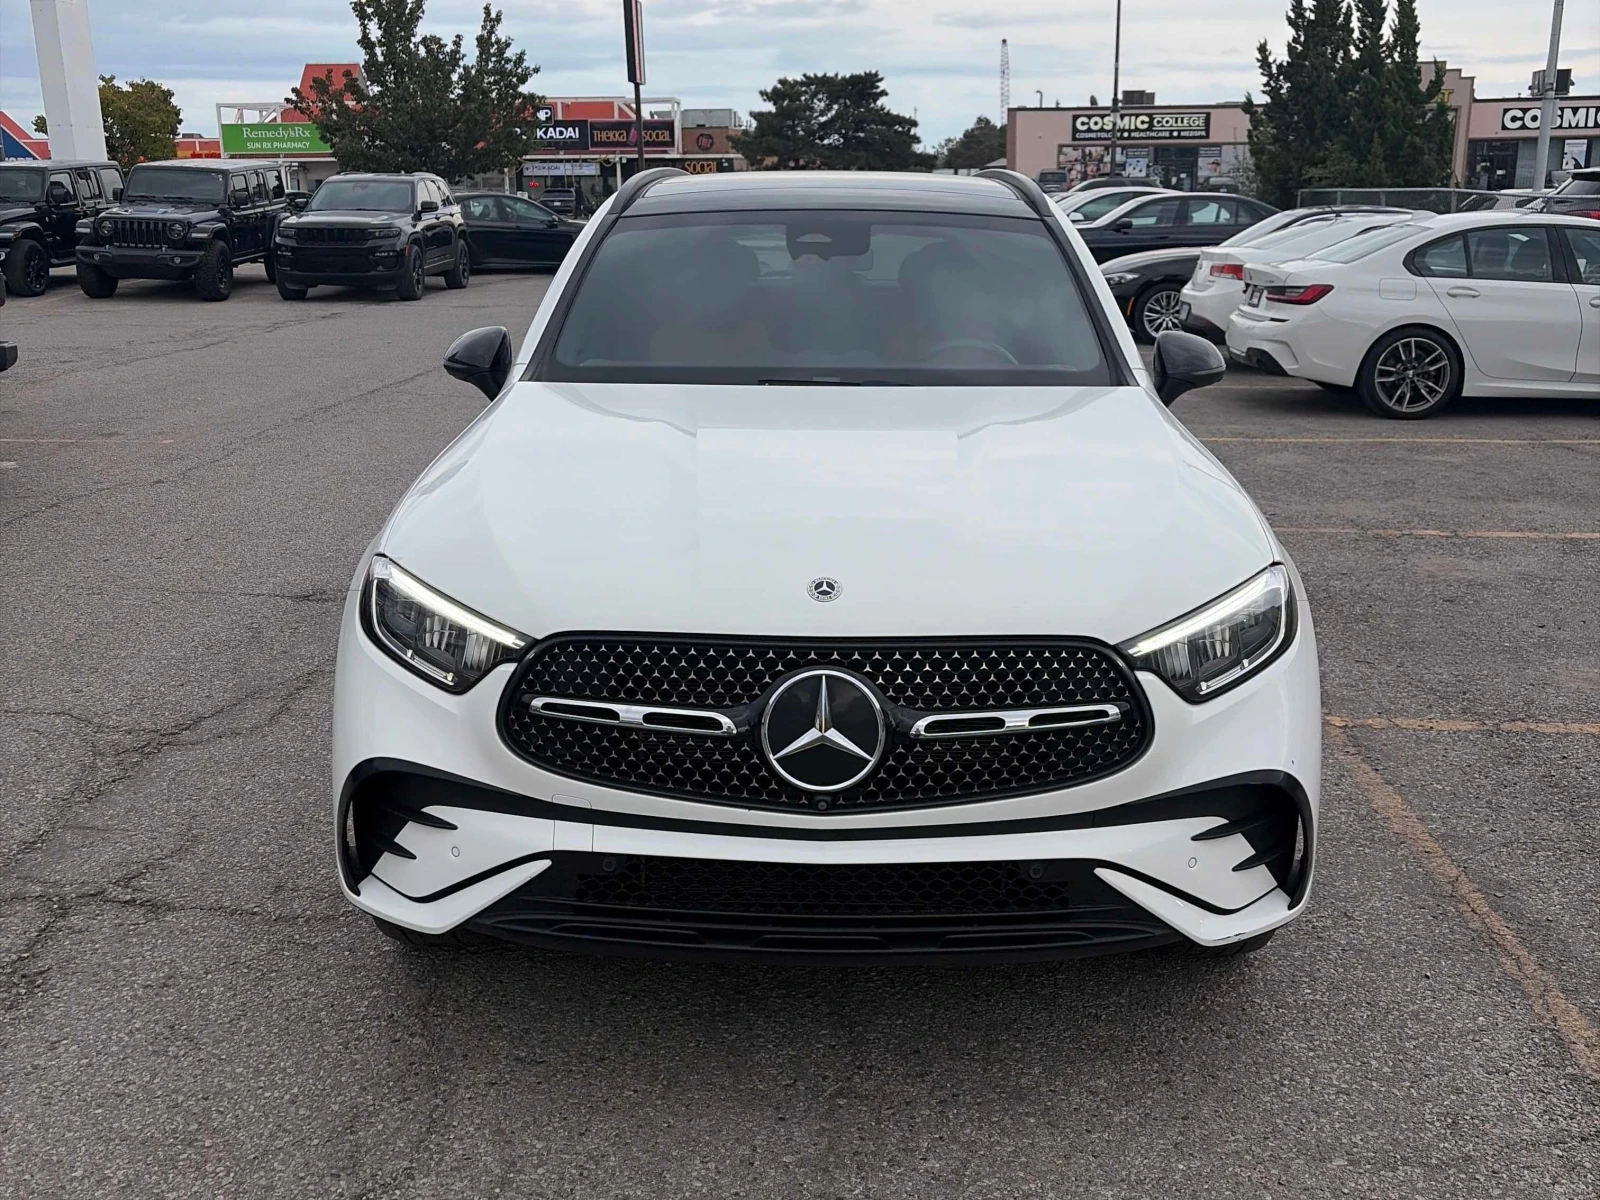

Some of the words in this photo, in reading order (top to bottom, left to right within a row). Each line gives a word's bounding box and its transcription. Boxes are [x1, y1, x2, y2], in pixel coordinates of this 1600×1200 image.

[1075, 115, 1150, 130] COSMIC
[1153, 117, 1206, 127] COLLEGE
[1503, 107, 1600, 129] COMI
[536, 127, 580, 139] KADAI
[273, 141, 310, 149] PHARMACY
